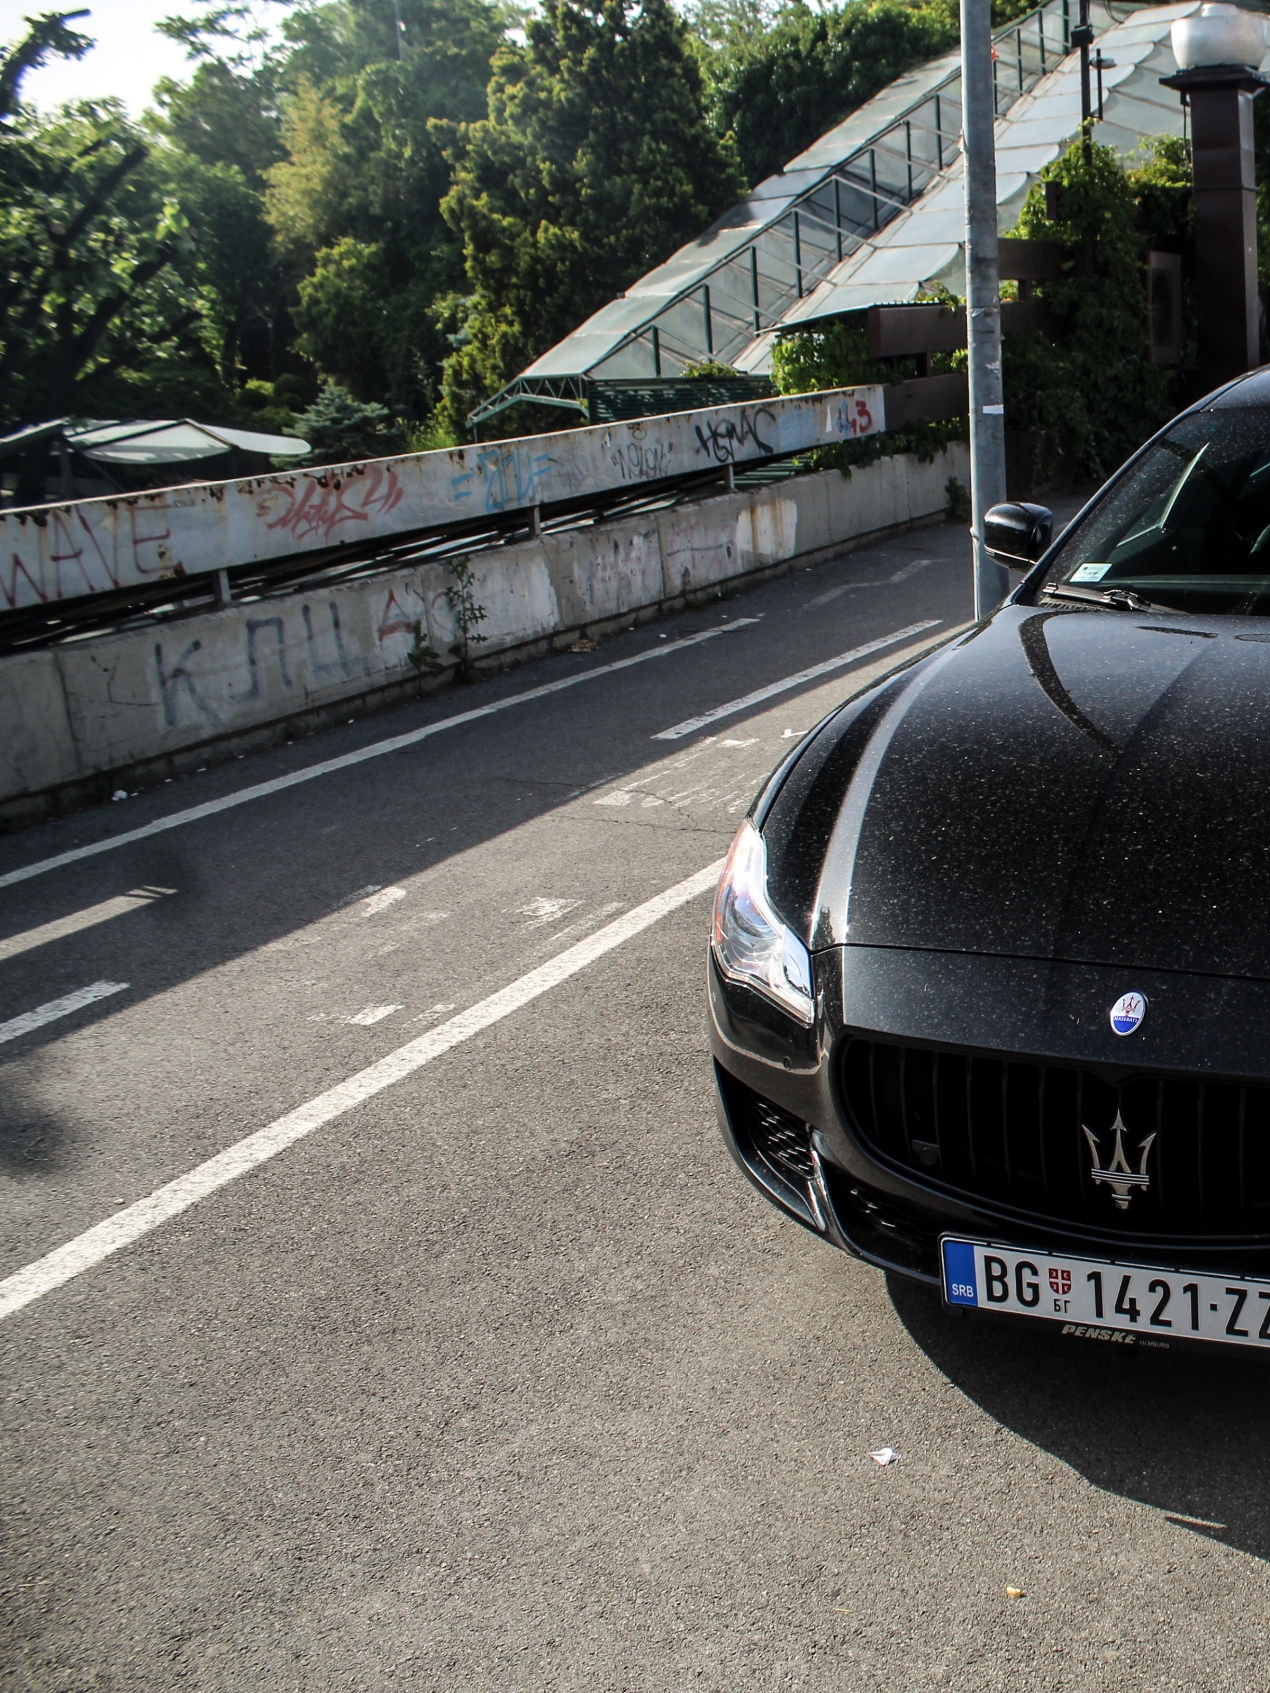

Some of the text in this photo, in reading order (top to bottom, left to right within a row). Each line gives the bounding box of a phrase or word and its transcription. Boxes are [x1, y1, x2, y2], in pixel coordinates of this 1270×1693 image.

[984, 1254, 1040, 1308] BG
[951, 1283, 974, 1298] SRB
[1053, 1298, 1071, 1314] БГ
[1062, 1324, 1136, 1343] PENSKE
